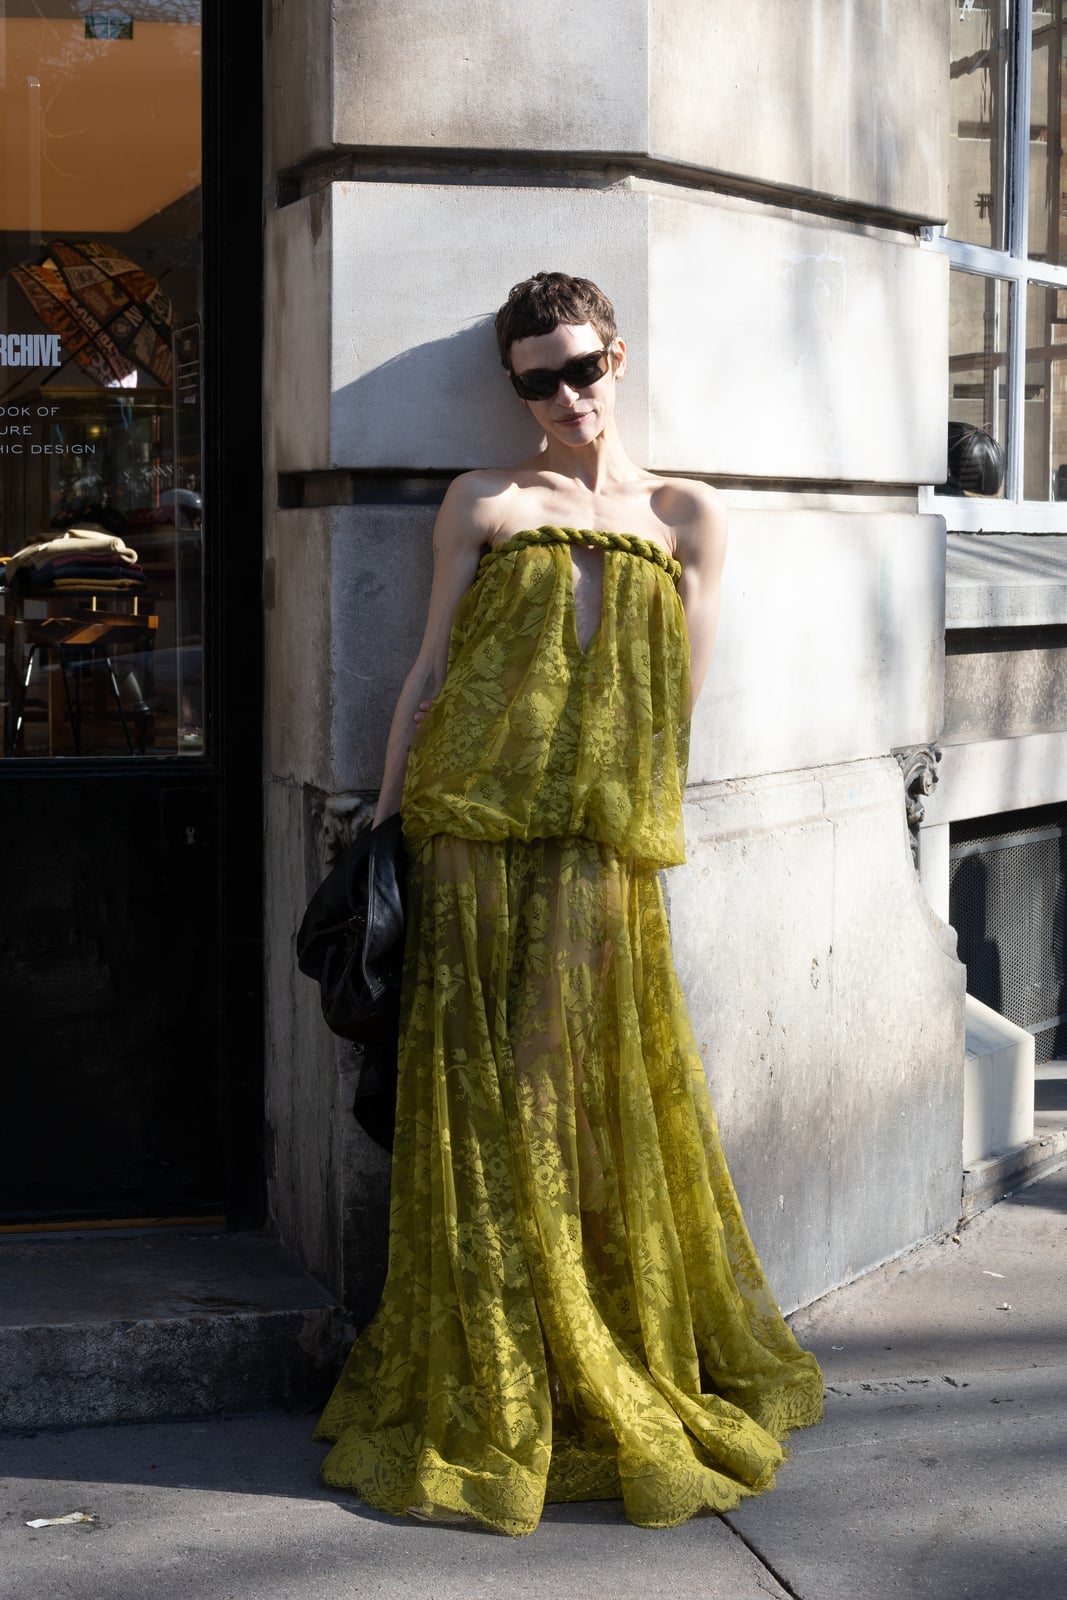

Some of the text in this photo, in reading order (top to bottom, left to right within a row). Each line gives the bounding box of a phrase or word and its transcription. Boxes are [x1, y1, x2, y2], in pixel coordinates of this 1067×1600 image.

[0, 334, 62, 367] RCHIVE
[37, 406, 60, 417] OF
[31, 444, 96, 454] DESIGN
